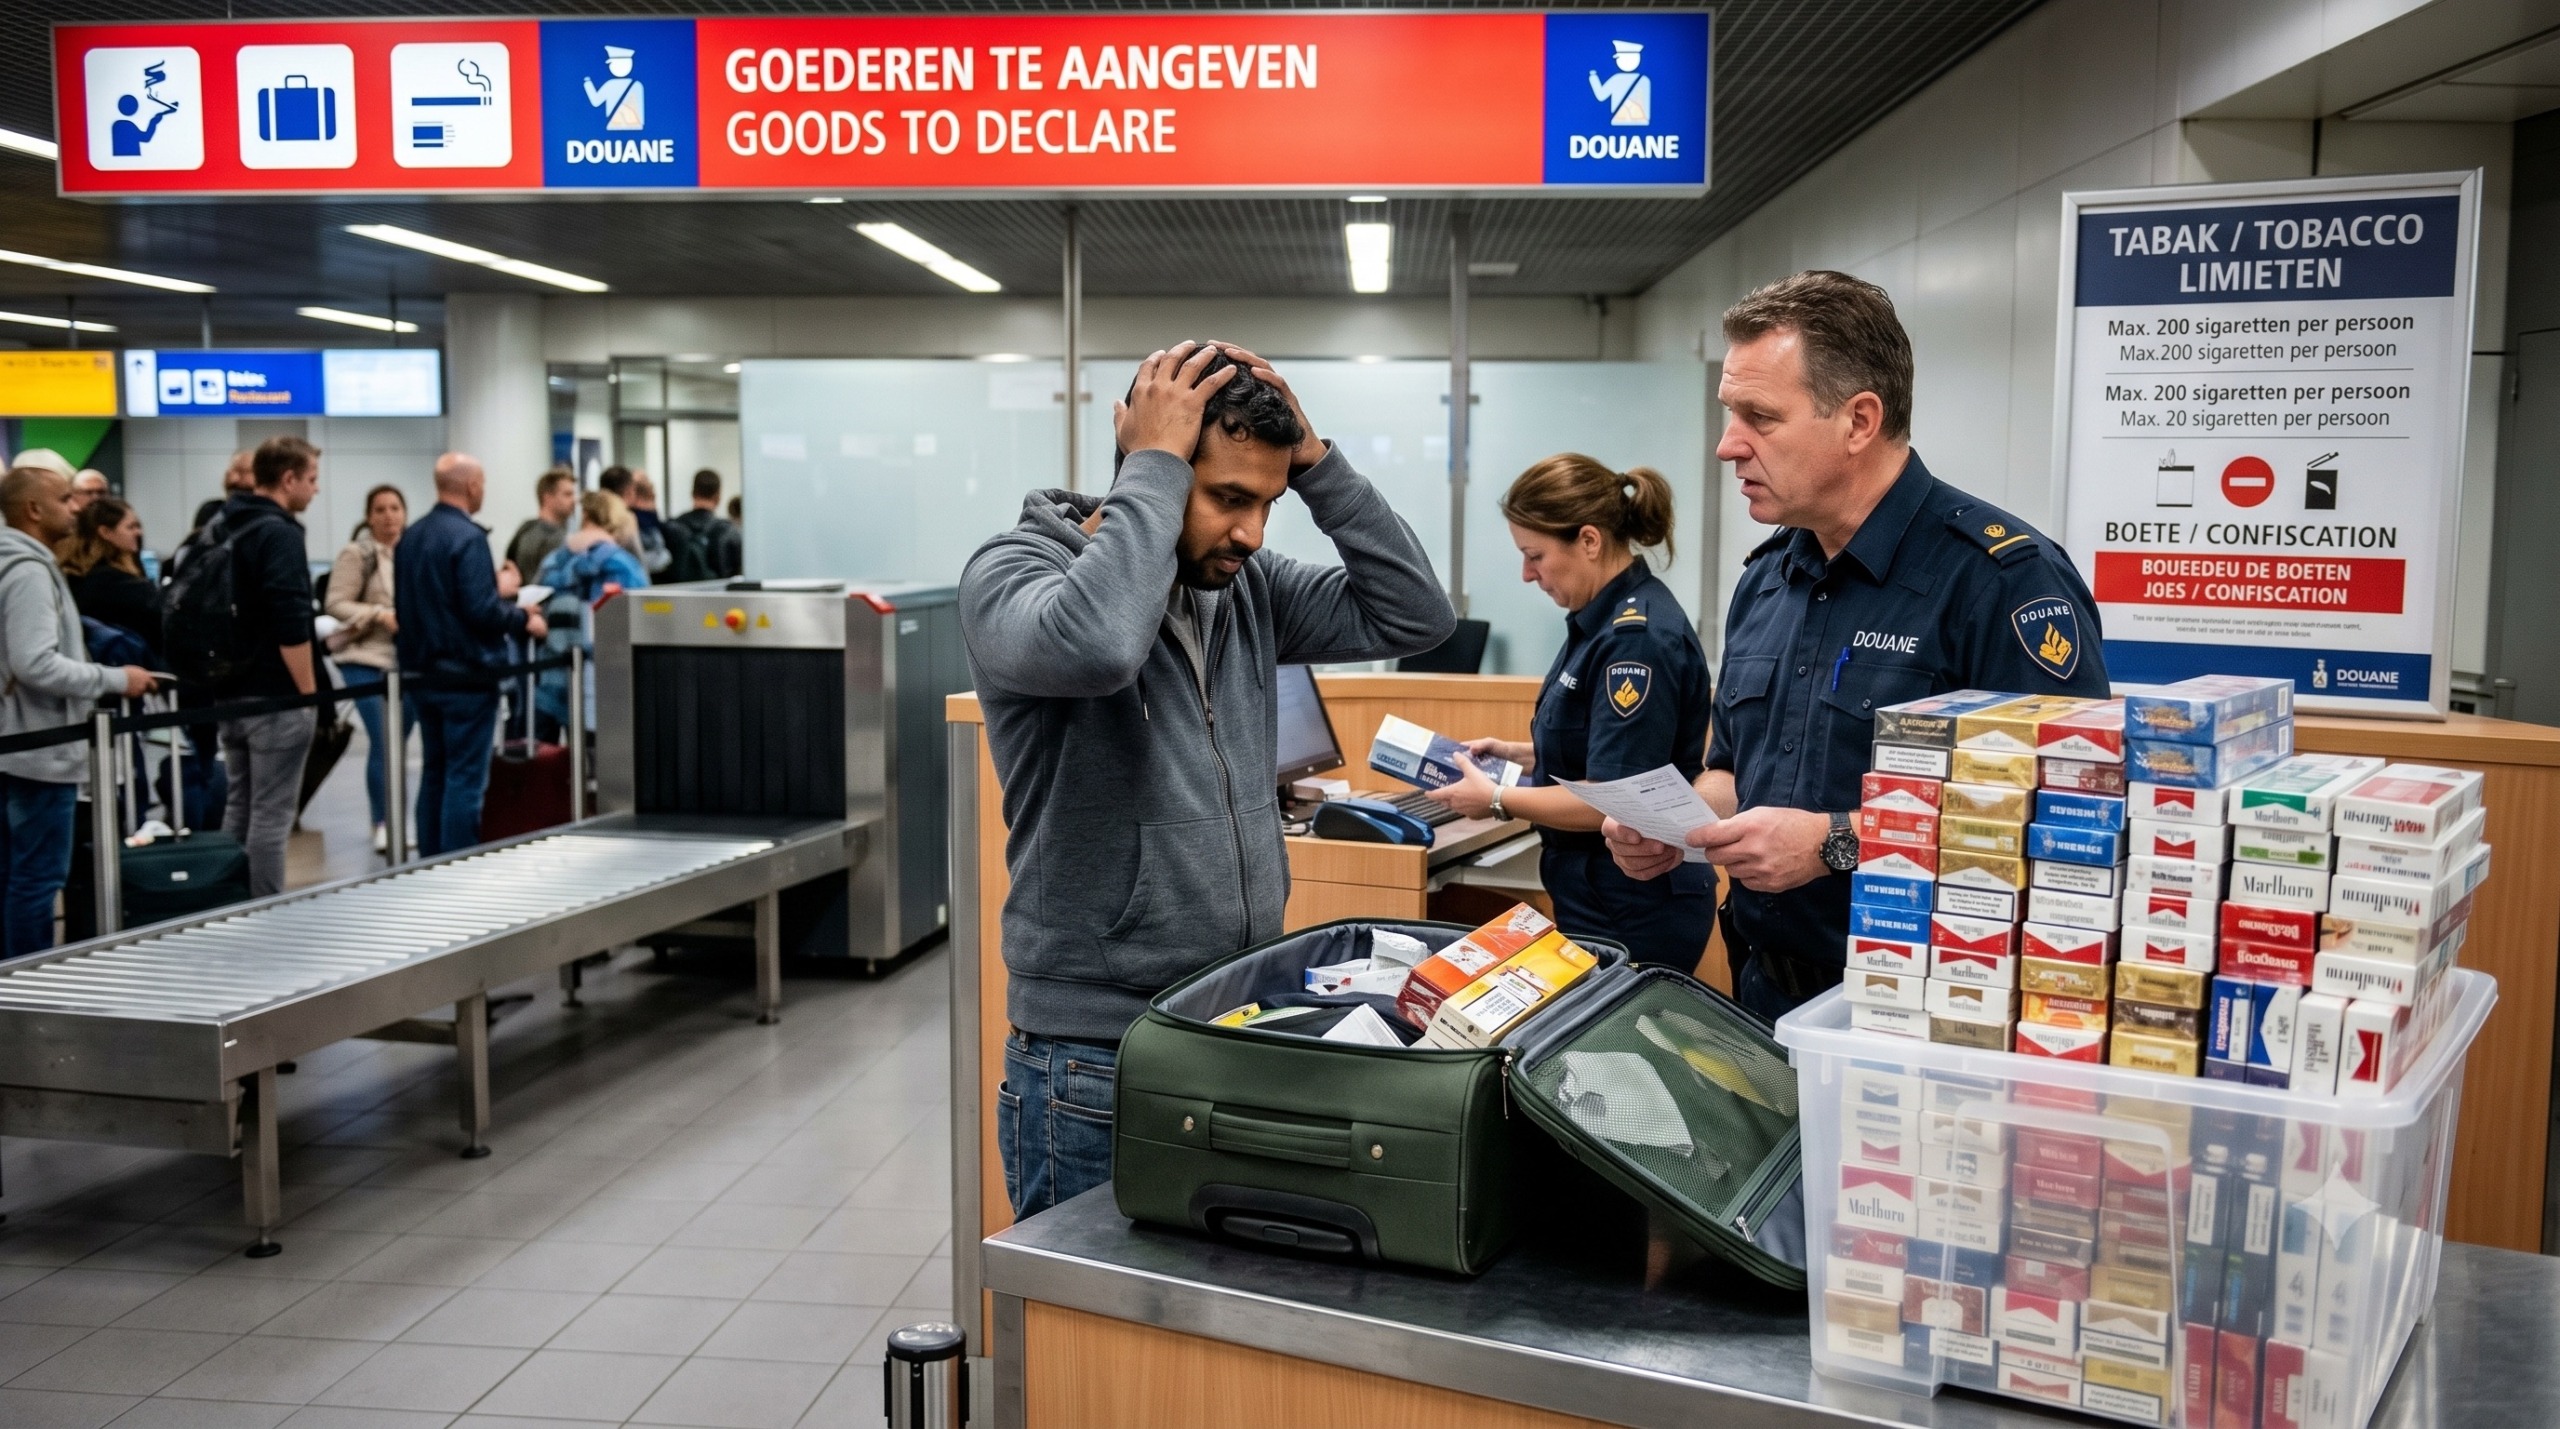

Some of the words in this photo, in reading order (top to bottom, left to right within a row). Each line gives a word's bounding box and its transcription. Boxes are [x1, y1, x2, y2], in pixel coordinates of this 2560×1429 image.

[725, 47, 974, 93] GOEDEREN
[989, 46, 1043, 91] TE
[1057, 44, 1317, 90] AANGEVEN
[725, 109, 887, 156] GOODS
[900, 109, 961, 155] TO
[976, 108, 1177, 154] DECLARE
[566, 139, 674, 163] DOUANE
[1569, 134, 1680, 159] DOUANE
[2109, 222, 2221, 257] TABAK
[2230, 221, 2244, 252] /
[2253, 213, 2424, 251] TOBACCO
[2179, 257, 2342, 293] LIMIETEN
[2108, 320, 2150, 336] Max.
[2156, 318, 2190, 335] 200
[2195, 316, 2290, 339] sigaretten
[2297, 318, 2329, 337] per
[2335, 316, 2414, 335] persoon
[2120, 343, 2192, 361] Max.200
[2198, 342, 2284, 365] sigaretten
[2290, 345, 2319, 362] per
[2324, 341, 2397, 362] persoon
[2105, 385, 2148, 402] Max.
[2153, 385, 2187, 401] 200
[2192, 383, 2288, 405] sigaretten
[2294, 385, 2326, 404] per
[2331, 383, 2411, 404] persoon
[2120, 410, 2160, 427] Max.
[2166, 410, 2187, 426] 20
[2192, 408, 2278, 431] sigaretten
[2283, 412, 2313, 430] per
[2317, 410, 2390, 431] persoon
[2105, 521, 2181, 544] BOETE
[2189, 522, 2199, 544] /
[2206, 523, 2397, 549] CONFISCATION
[2141, 558, 2241, 578] BOUEEDEU
[2245, 561, 2271, 579] DE
[2275, 562, 2351, 582] BOETEN
[2144, 581, 2187, 600] JOES
[2191, 583, 2200, 599] /
[2204, 583, 2348, 605] CONFISCATION
[2019, 604, 2071, 624] DOUANE
[1853, 630, 1920, 654] DOUANE
[1611, 667, 1647, 677] DOUANE
[2336, 668, 2400, 684] DOUANE
[2243, 875, 2314, 899] Marlboro
